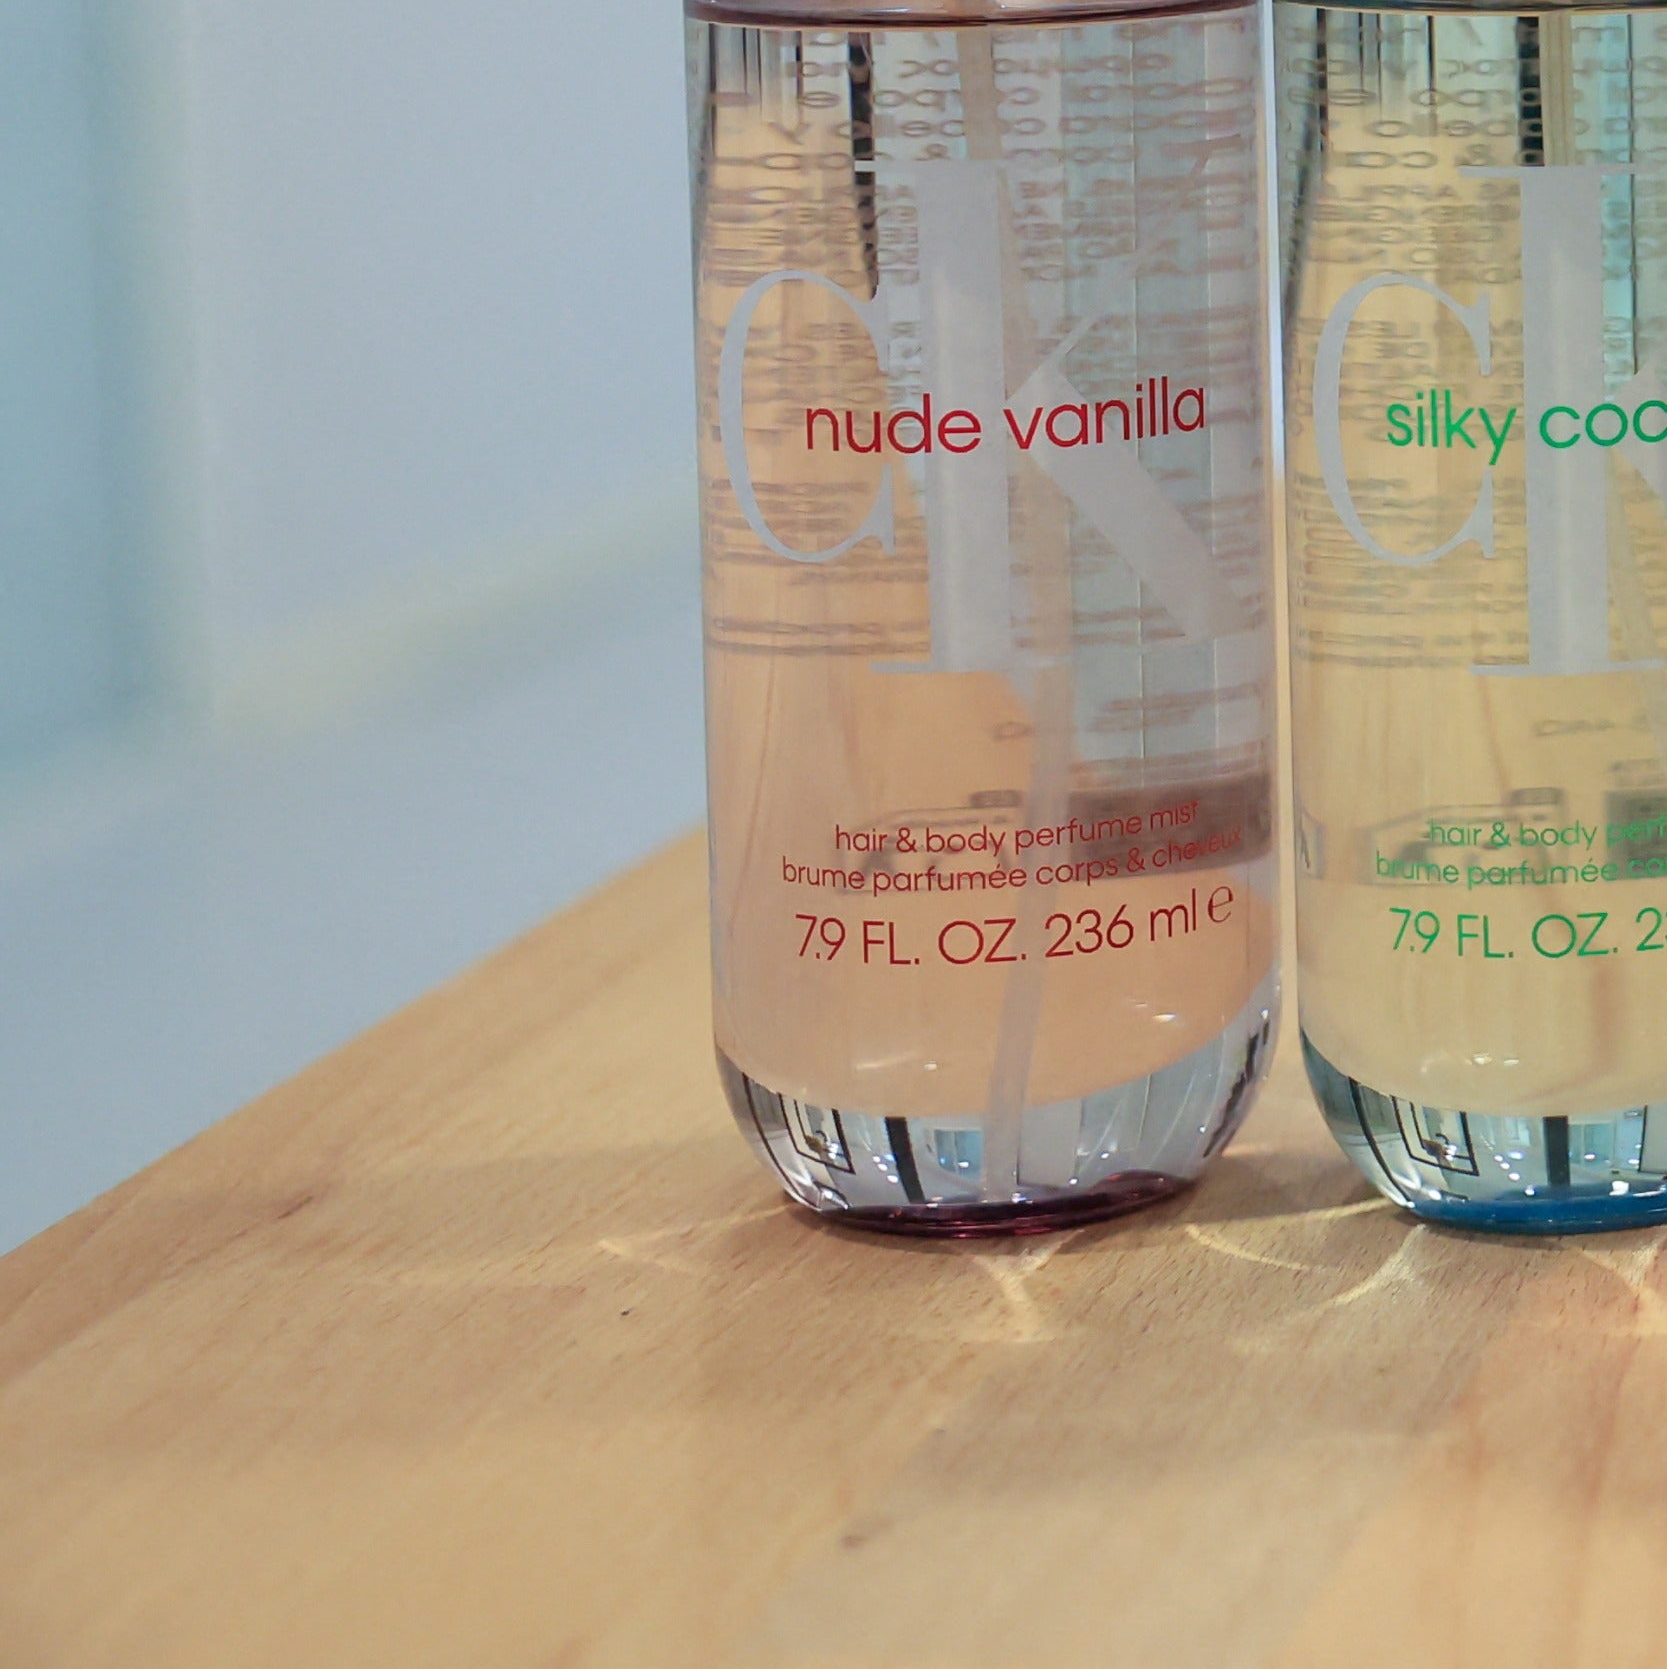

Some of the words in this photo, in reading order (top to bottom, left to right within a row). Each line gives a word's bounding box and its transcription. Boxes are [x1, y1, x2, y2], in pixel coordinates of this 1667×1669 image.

[805, 393, 982, 454] nude
[1003, 376, 1206, 451] vanilla
[1385, 388, 1517, 467] silky
[835, 823, 889, 854] hair
[896, 826, 923, 855] &
[925, 824, 1008, 858] body
[1014, 812, 1144, 854] perfume
[1149, 799, 1203, 835] mist
[1427, 817, 1483, 848] hair
[1490, 820, 1513, 850] &
[1518, 819, 1599, 851] body
[782, 855, 866, 891] brume
[872, 861, 1028, 898] parfumée
[1035, 854, 1119, 886] corps
[1125, 846, 1147, 873] &
[1375, 850, 1460, 884] brume
[1467, 856, 1619, 891] parfumée
[794, 913, 847, 963] 7.9
[861, 919, 921, 966] FL.
[937, 917, 1028, 966] OZ.
[1043, 904, 1135, 960] 236
[1148, 886, 1198, 944] ml
[1388, 905, 1441, 955] 7.9
[1456, 912, 1515, 960] FL.
[1531, 911, 1620, 960] OZ.
